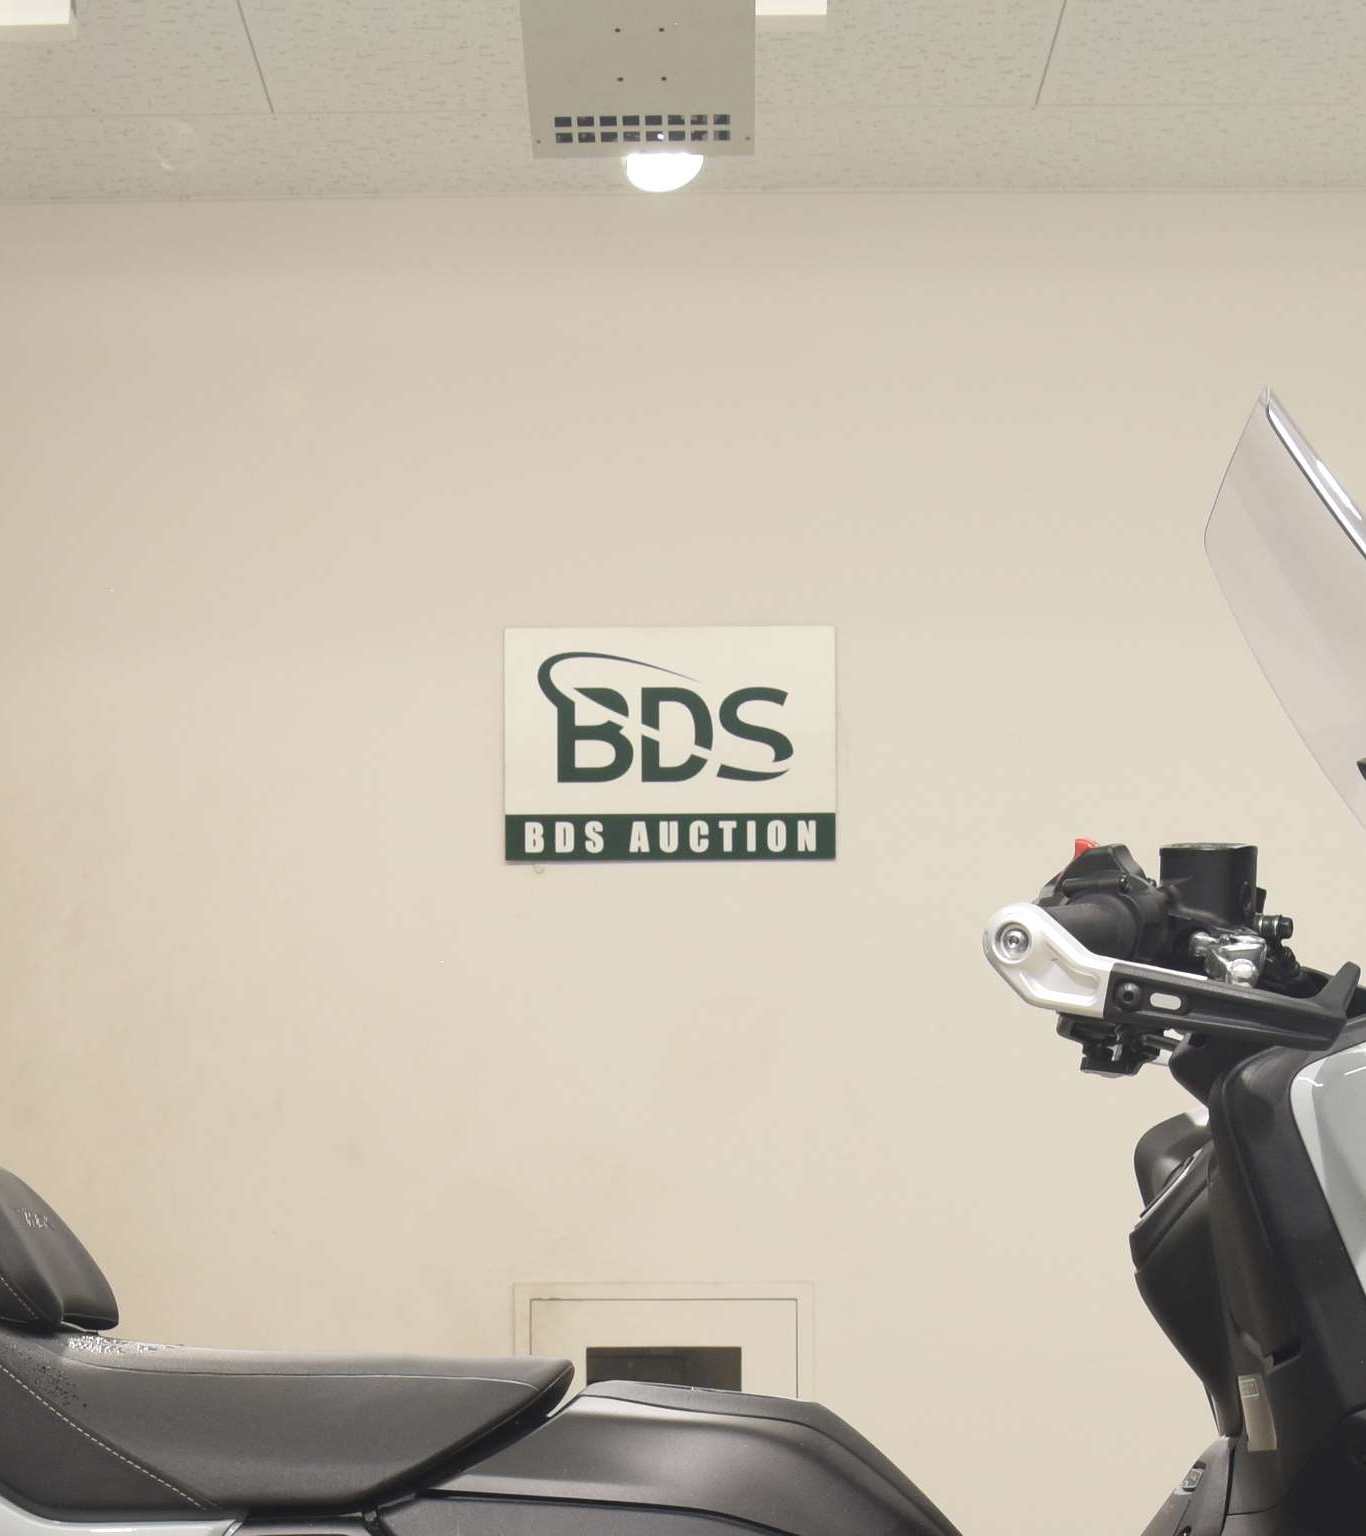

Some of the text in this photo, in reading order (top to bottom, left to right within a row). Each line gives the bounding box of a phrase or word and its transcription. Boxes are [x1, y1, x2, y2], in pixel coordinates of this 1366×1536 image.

[537, 651, 794, 783] BDS
[524, 820, 817, 854] BDS AUCTION
